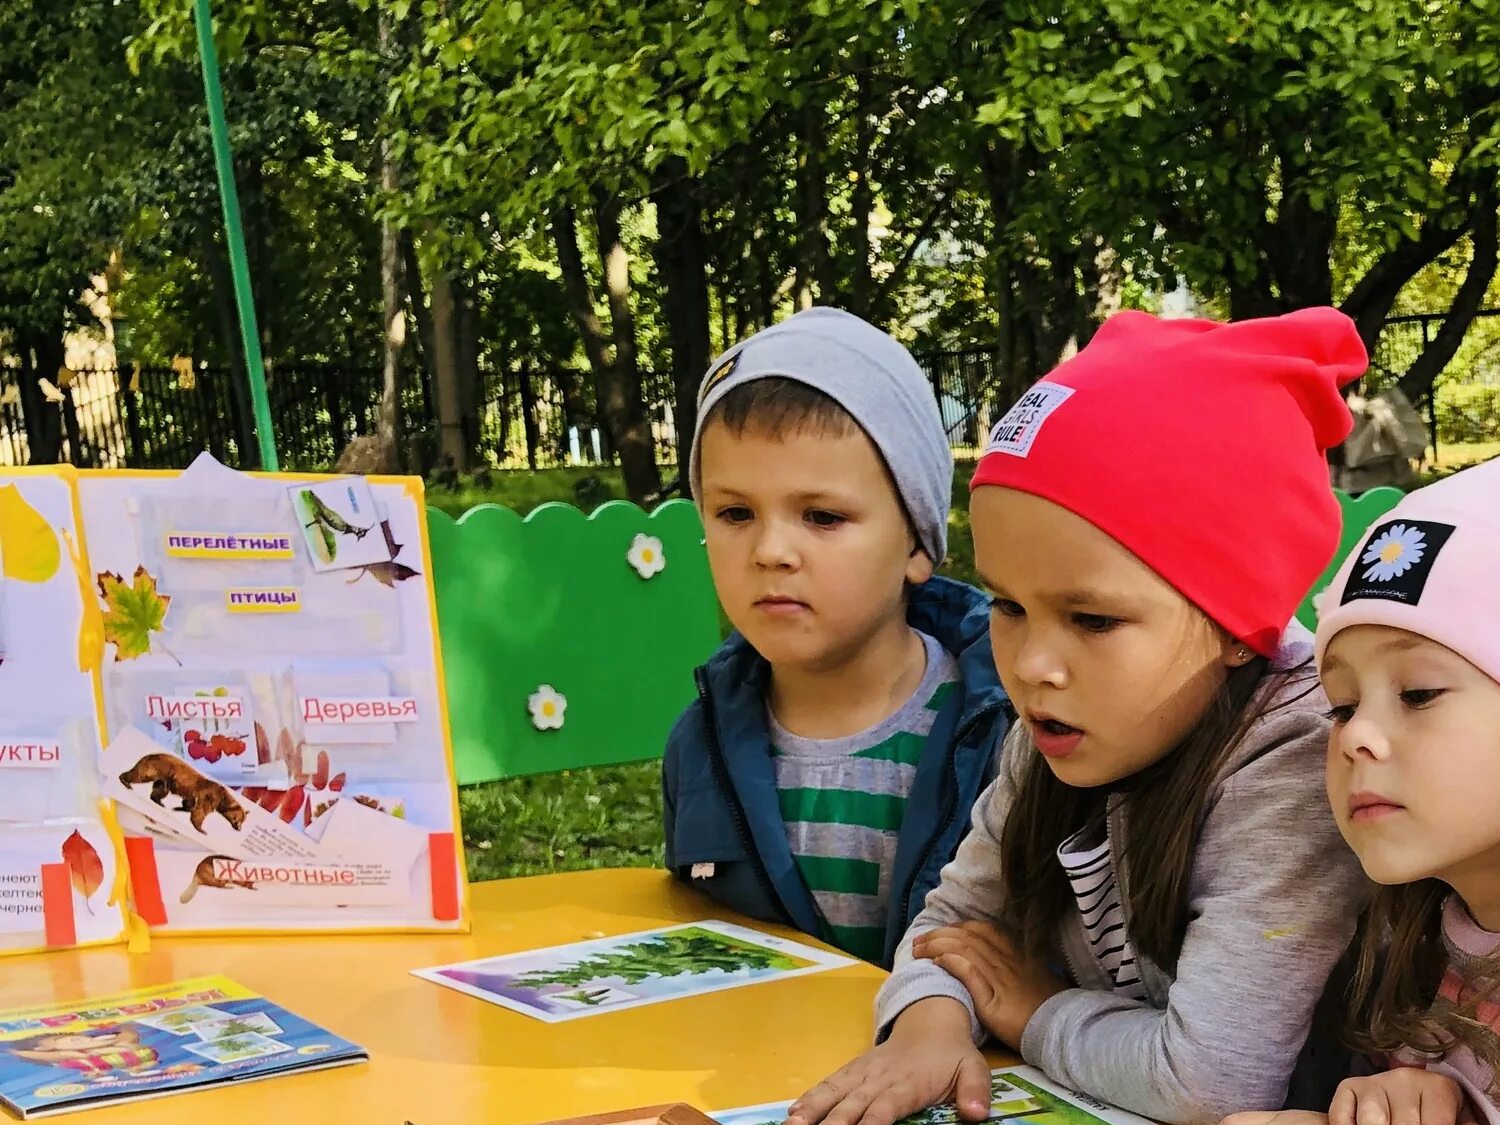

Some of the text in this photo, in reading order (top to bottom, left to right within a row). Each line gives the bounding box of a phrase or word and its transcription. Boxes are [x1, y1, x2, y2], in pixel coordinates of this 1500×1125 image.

[1003, 409, 1039, 425] GIRLS
[992, 425, 1026, 443] RULE!
[168, 536, 290, 549] ПЕРЕЛЁТНЫЕ
[230, 592, 297, 604] ПТИЦЫ
[148, 696, 242, 717] Листья
[303, 698, 417, 723] Деревья
[217, 859, 356, 884] Животные
